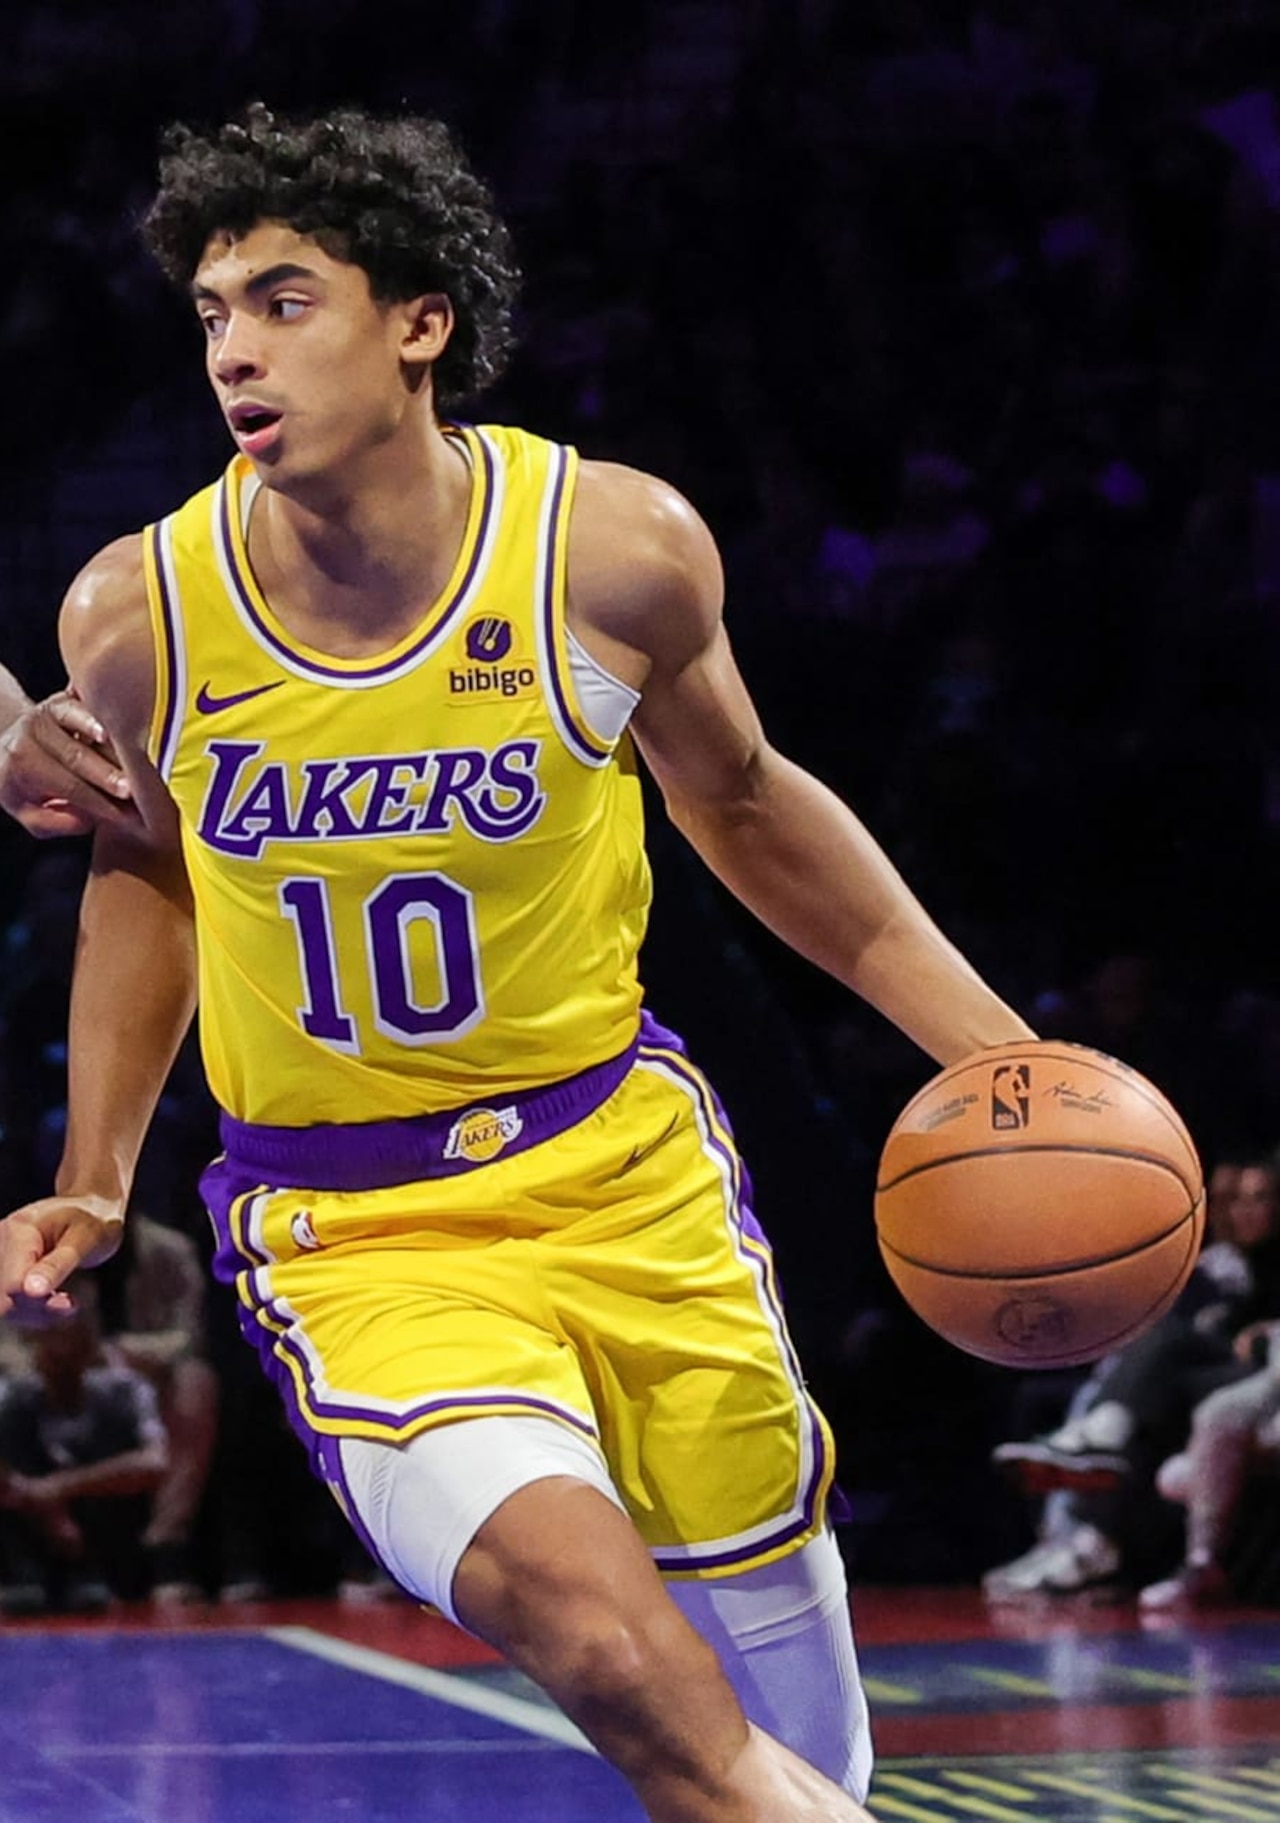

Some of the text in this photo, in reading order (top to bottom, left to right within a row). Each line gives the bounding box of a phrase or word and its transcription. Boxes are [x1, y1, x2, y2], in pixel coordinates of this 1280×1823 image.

[450, 667, 534, 696] bibigo
[198, 740, 546, 860] LAKERS
[277, 871, 485, 1056] 10
